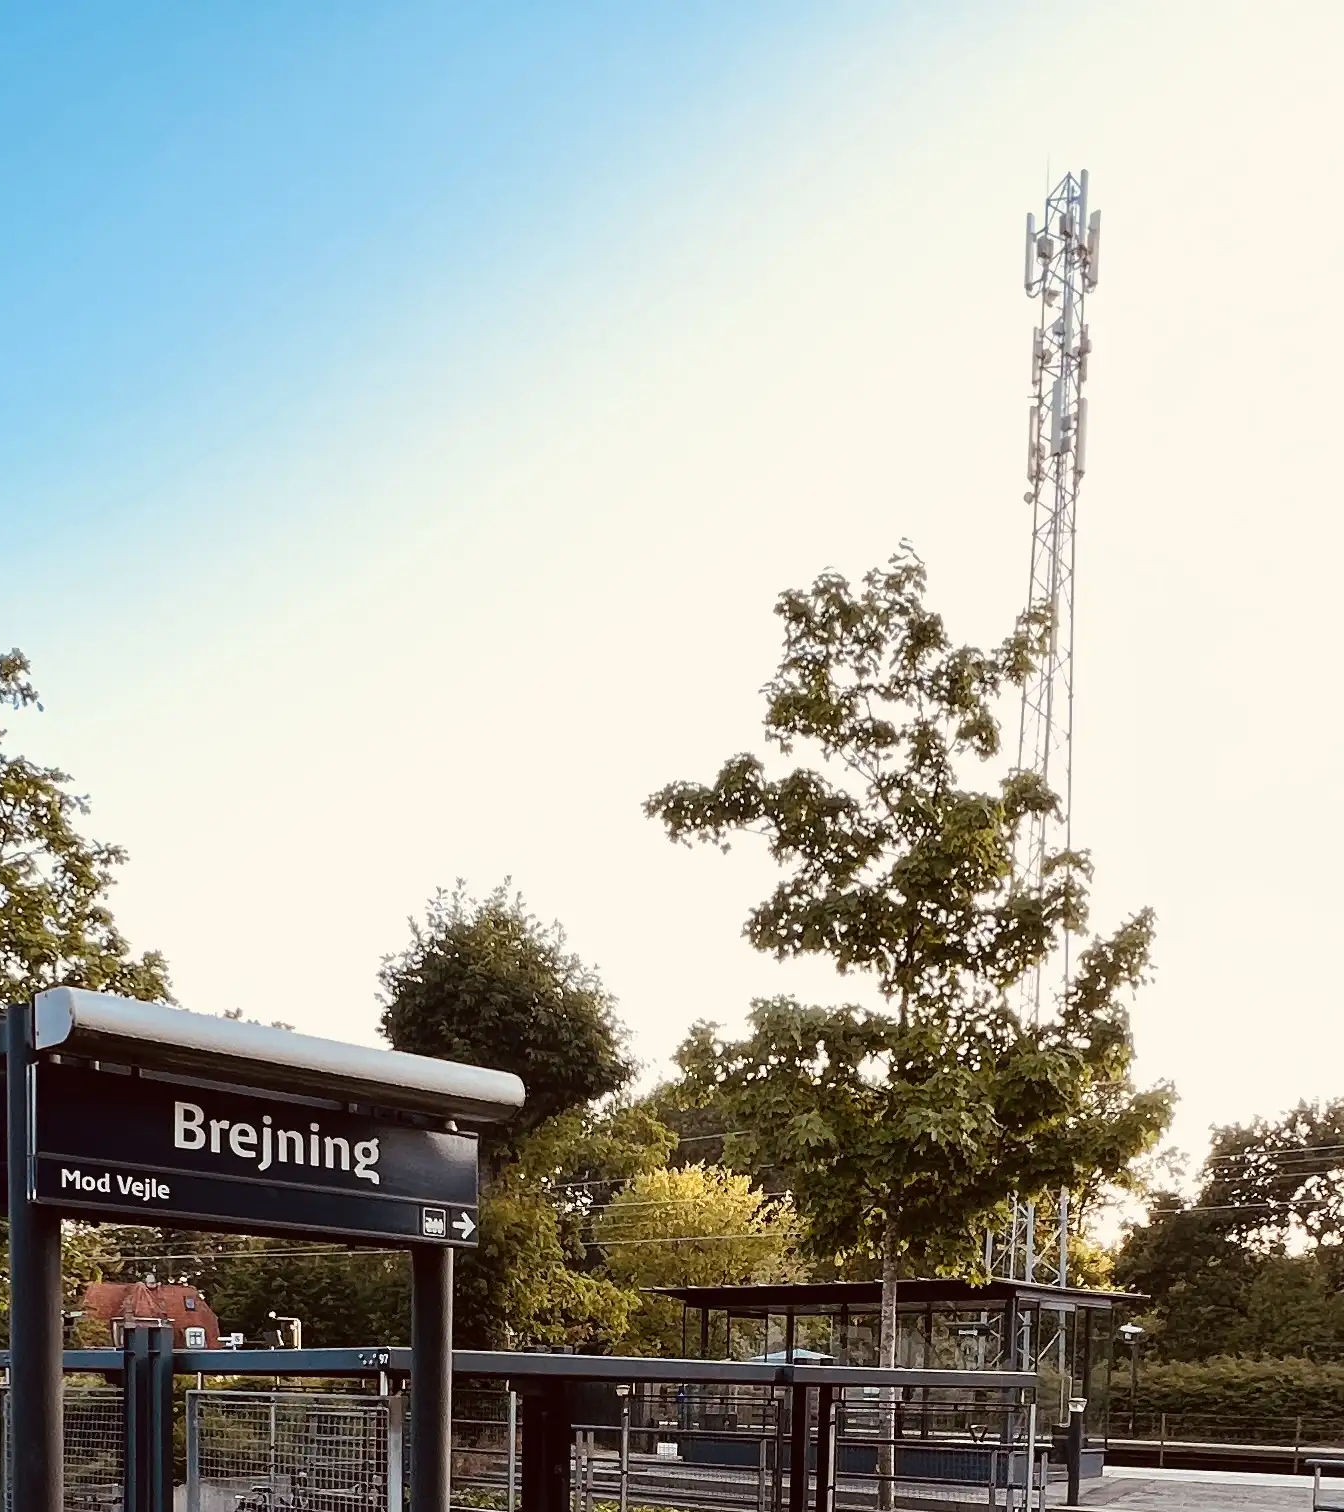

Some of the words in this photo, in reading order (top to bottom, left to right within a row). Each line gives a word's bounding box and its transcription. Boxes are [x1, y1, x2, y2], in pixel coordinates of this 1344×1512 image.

[174, 1101, 380, 1185] Brejning
[61, 1168, 111, 1193] Mod
[116, 1174, 171, 1202] Vejle
